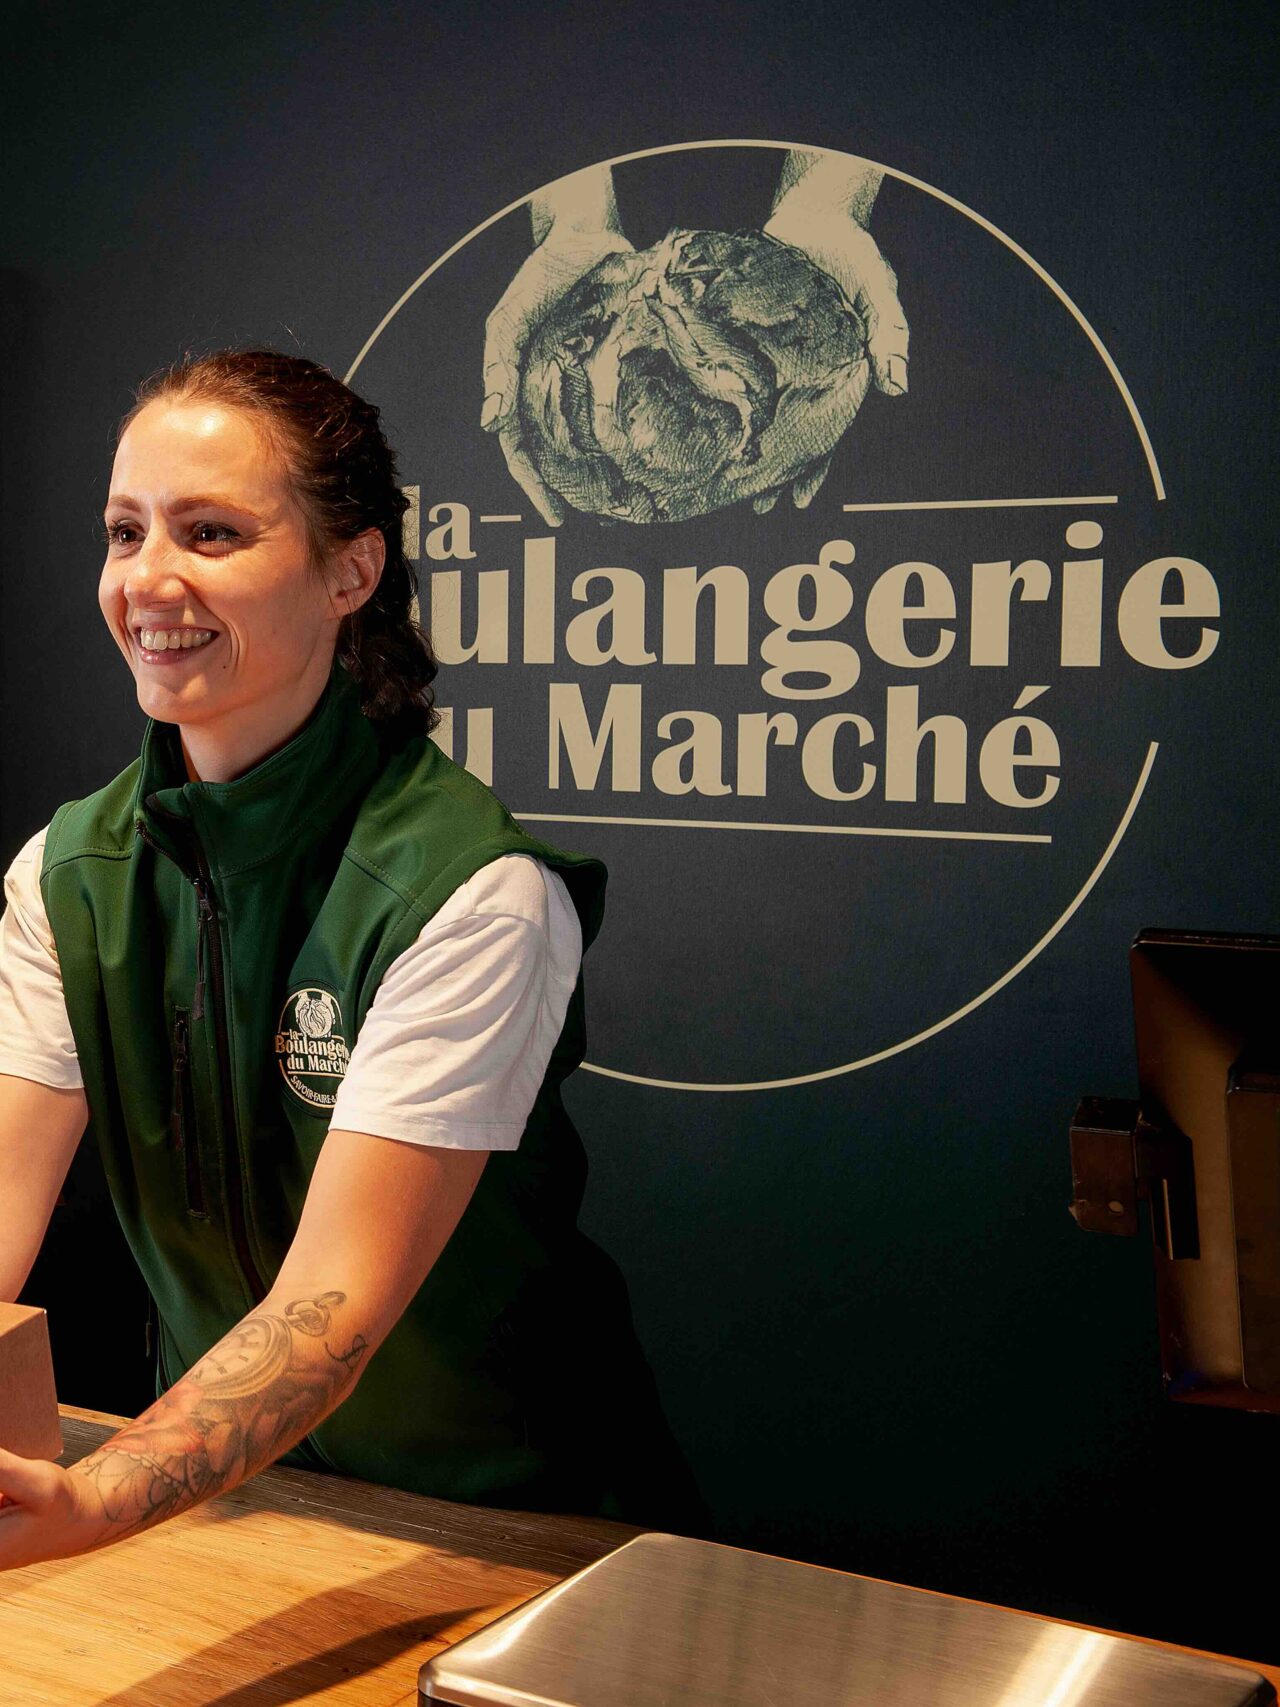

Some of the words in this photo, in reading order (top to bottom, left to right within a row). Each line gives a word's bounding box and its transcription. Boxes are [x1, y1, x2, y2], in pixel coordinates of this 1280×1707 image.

[402, 485, 477, 560] la
[410, 520, 1221, 702] ulangerie
[427, 707, 493, 787] u
[548, 683, 1061, 809] Marché
[287, 1054, 304, 1070] du
[290, 1029, 299, 1040] la
